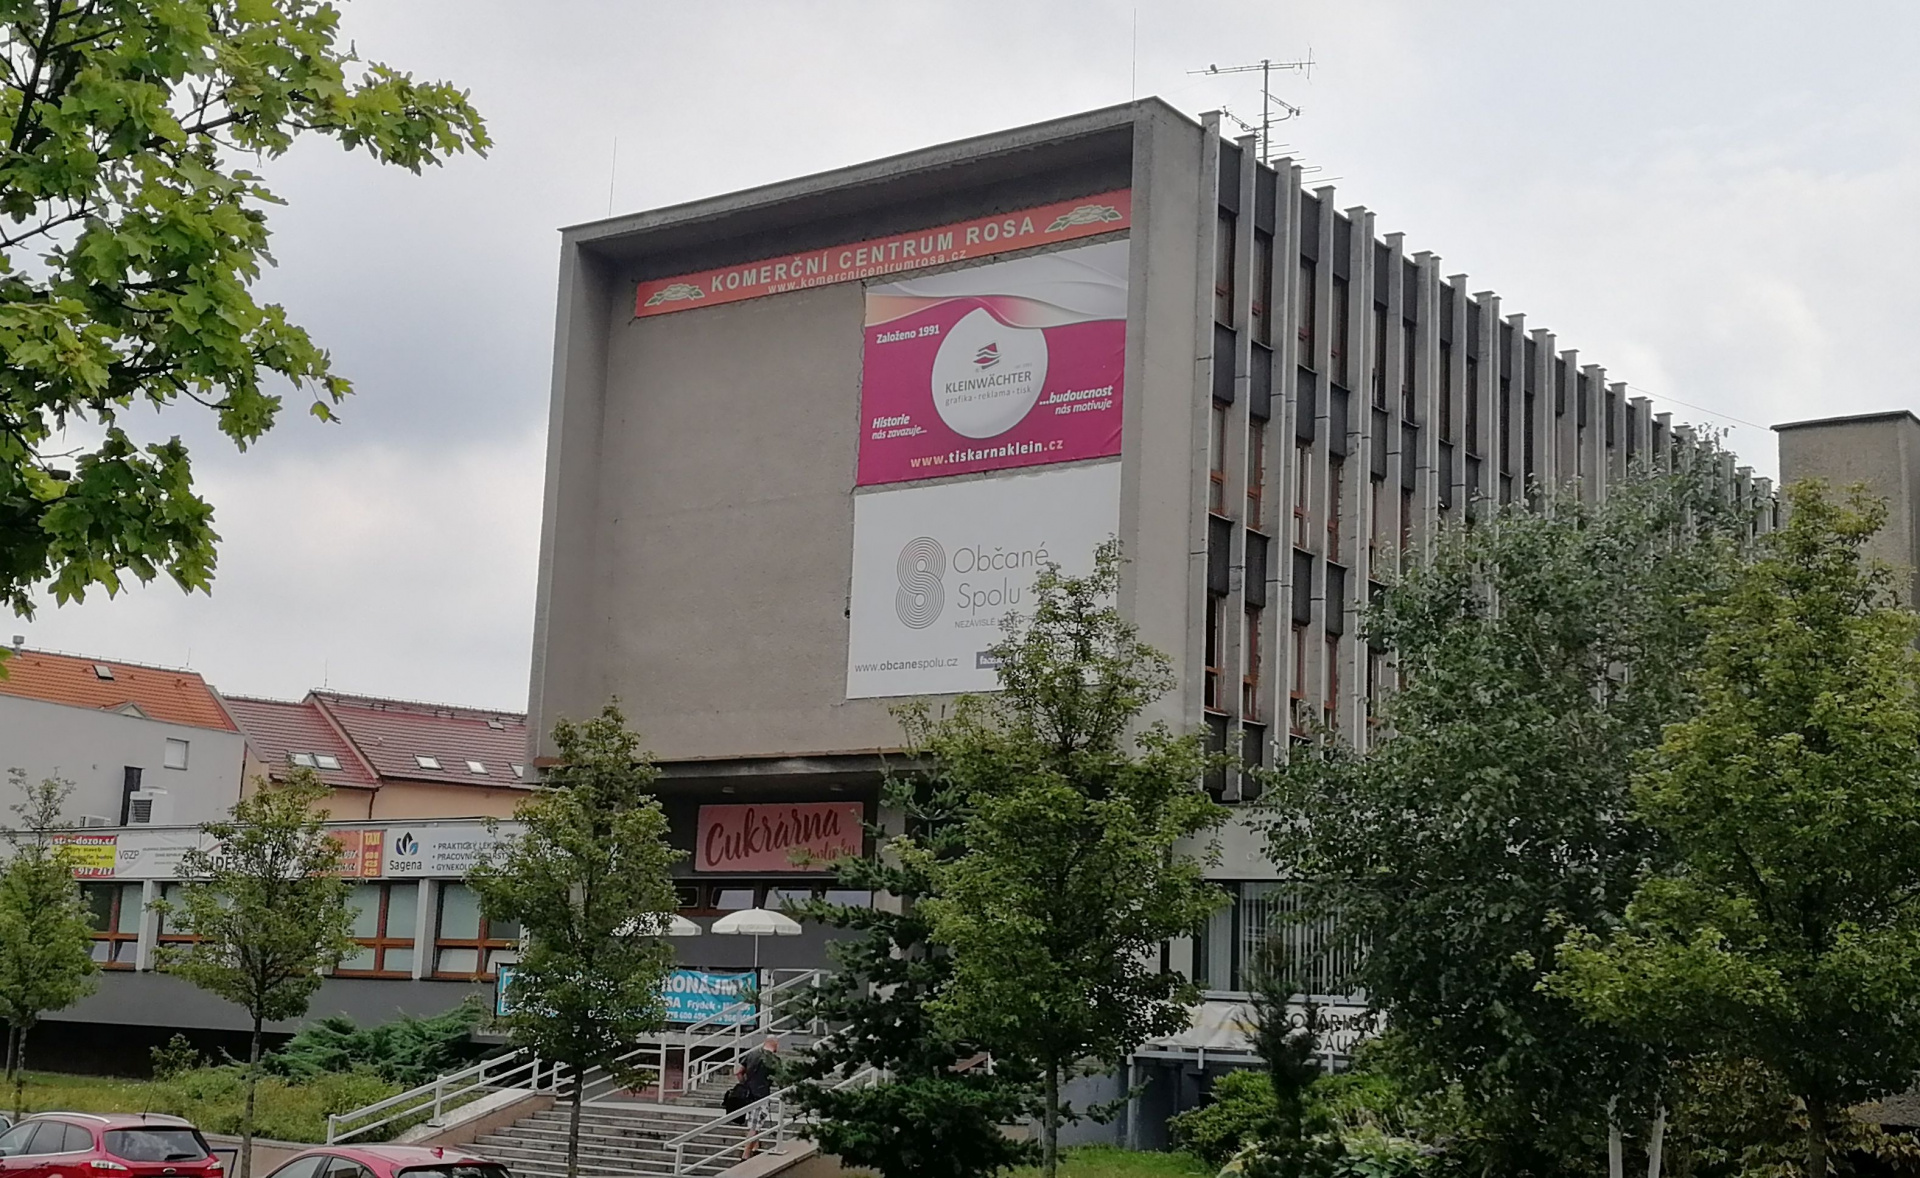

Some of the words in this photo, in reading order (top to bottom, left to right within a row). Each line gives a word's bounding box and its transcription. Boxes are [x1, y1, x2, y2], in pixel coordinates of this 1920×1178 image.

[711, 251, 828, 293] KOMERČNÍ
[839, 232, 954, 269] CENTRUM
[966, 217, 1035, 246] ROSA
[768, 250, 967, 294] www.komercnicentrumrosa.cz
[876, 328, 916, 344] Založeno
[918, 324, 940, 338] 1991
[945, 371, 1032, 394] KLEINWÄCHTER
[945, 393, 973, 407] grafika
[978, 389, 1011, 401] reklama
[1016, 386, 1032, 395] tisk
[1055, 403, 1072, 415] nás
[1073, 399, 1112, 414] motivuje
[872, 413, 910, 429] Historie
[871, 428, 886, 440] nás
[910, 439, 1064, 468] www.tiskarnaklein.cz
[953, 541, 1050, 573] Občané
[957, 577, 1022, 616] Spolu
[955, 617, 996, 629] NEZÁVISLÉ
[855, 657, 959, 673] www.obcanespolu.cz
[364, 832, 381, 845] TAXI
[705, 807, 841, 867] Cukrárna
[389, 860, 422, 872] Sagena
